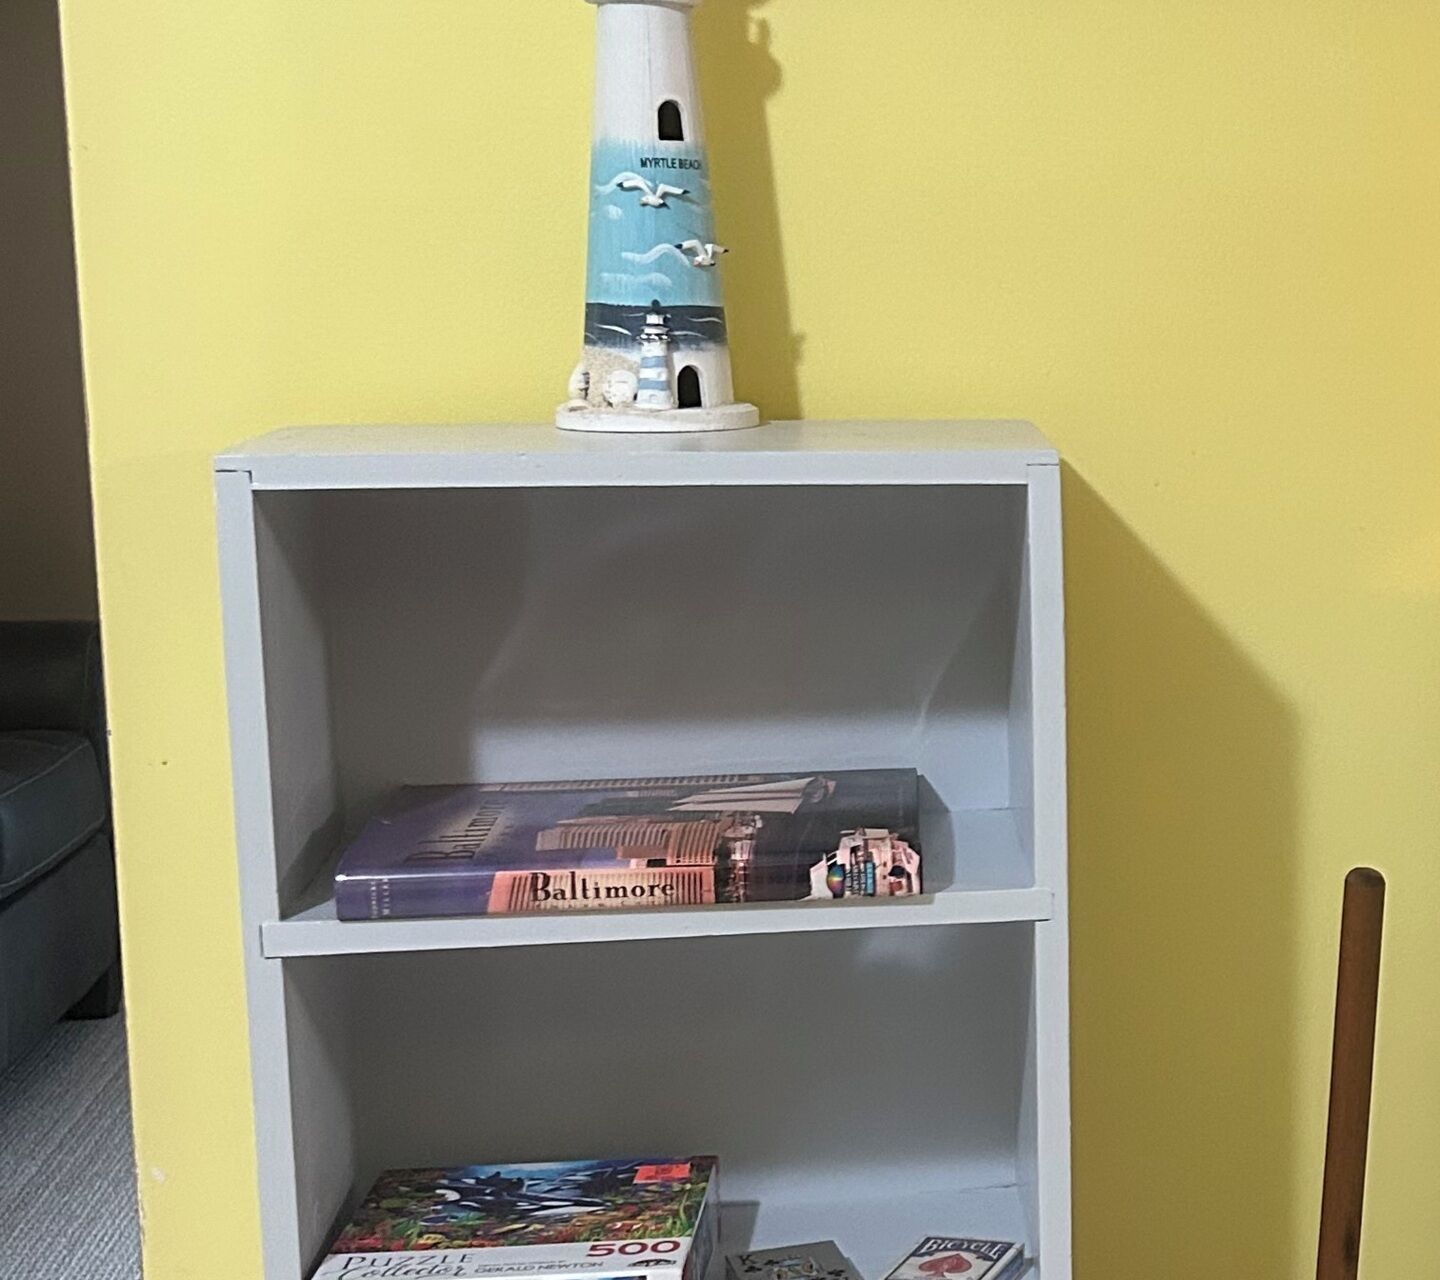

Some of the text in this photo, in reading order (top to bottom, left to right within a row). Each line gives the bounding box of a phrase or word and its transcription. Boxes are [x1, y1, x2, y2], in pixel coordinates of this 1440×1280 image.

[640, 157, 678, 169] MYRTLE
[529, 871, 675, 903] Baltimore
[585, 1240, 681, 1257] 500
[920, 1238, 1003, 1261] BICYCLE
[342, 1253, 477, 1270] PUZZLE
[474, 1264, 536, 1274] GERALD
[536, 1261, 604, 1271] NEWTON
[738, 1255, 757, 1265] K
